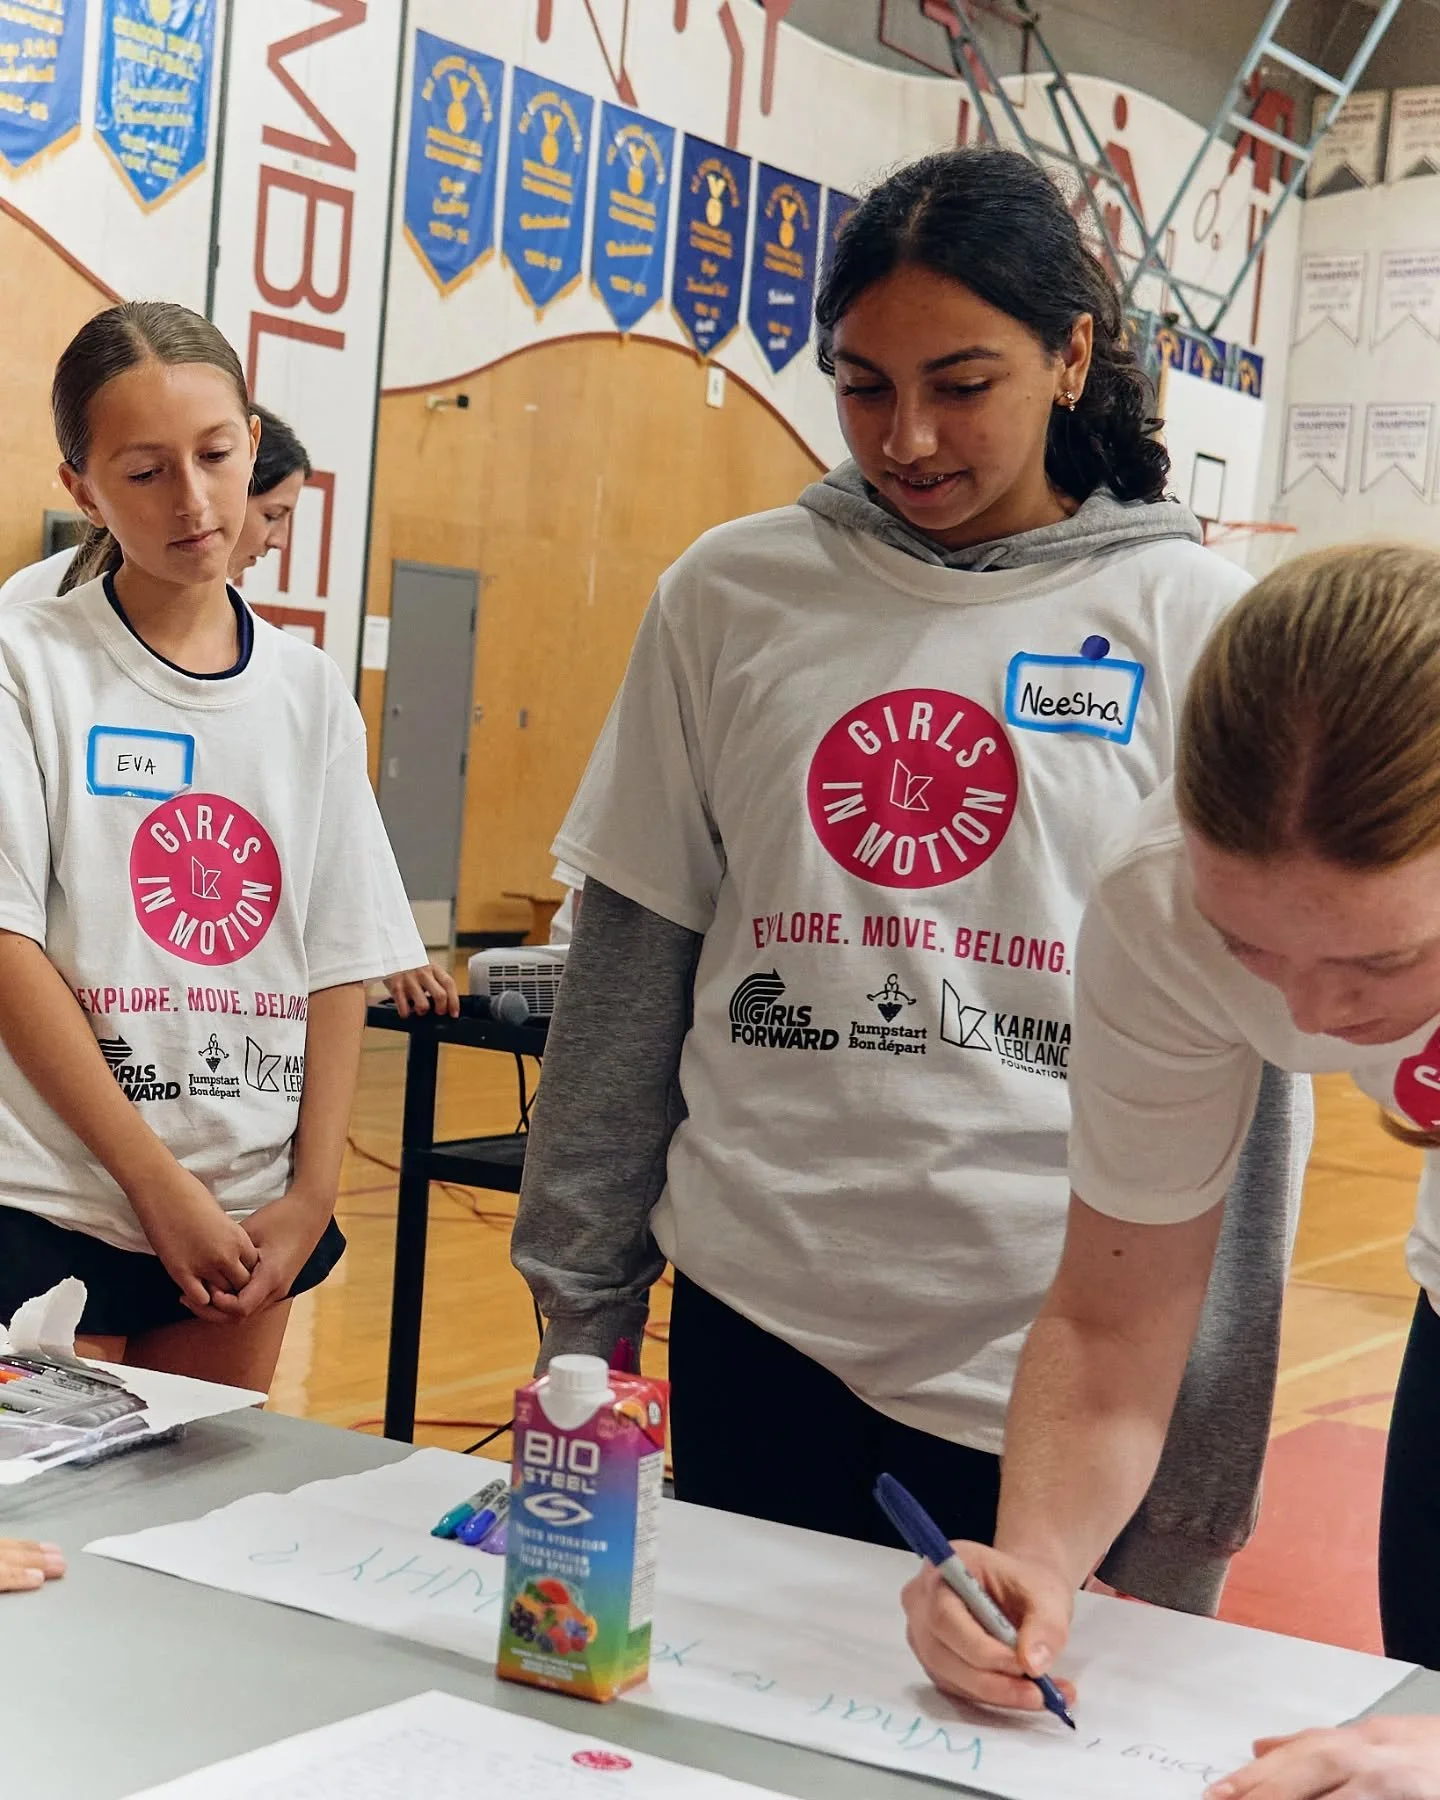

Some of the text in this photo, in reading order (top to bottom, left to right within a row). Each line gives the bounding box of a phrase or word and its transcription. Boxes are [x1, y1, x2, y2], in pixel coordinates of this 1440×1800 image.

[1020, 682, 1124, 726] Neesha
[847, 701, 997, 768] GIRLS
[117, 754, 157, 776] EVA
[150, 804, 262, 865] GIRLS
[822, 781, 1007, 876] IN MOTION
[137, 876, 273, 956] IN MOTION
[752, 911, 1072, 976] ELORE. MOVE. BELONG.
[187, 987, 248, 1016] MOVE.
[731, 1023, 840, 1051] FORWARD
[849, 1021, 928, 1040] Jumpstart
[993, 1012, 1072, 1046] KARINA
[994, 1036, 1070, 1068] LEBLANC
[188, 1073, 241, 1087] Jumpstart
[1000, 1057, 1068, 1080] FOUNDATION
[118, 1081, 182, 1102] WARD
[523, 1429, 601, 1475] BIO
[522, 1465, 598, 1495] STEEL
